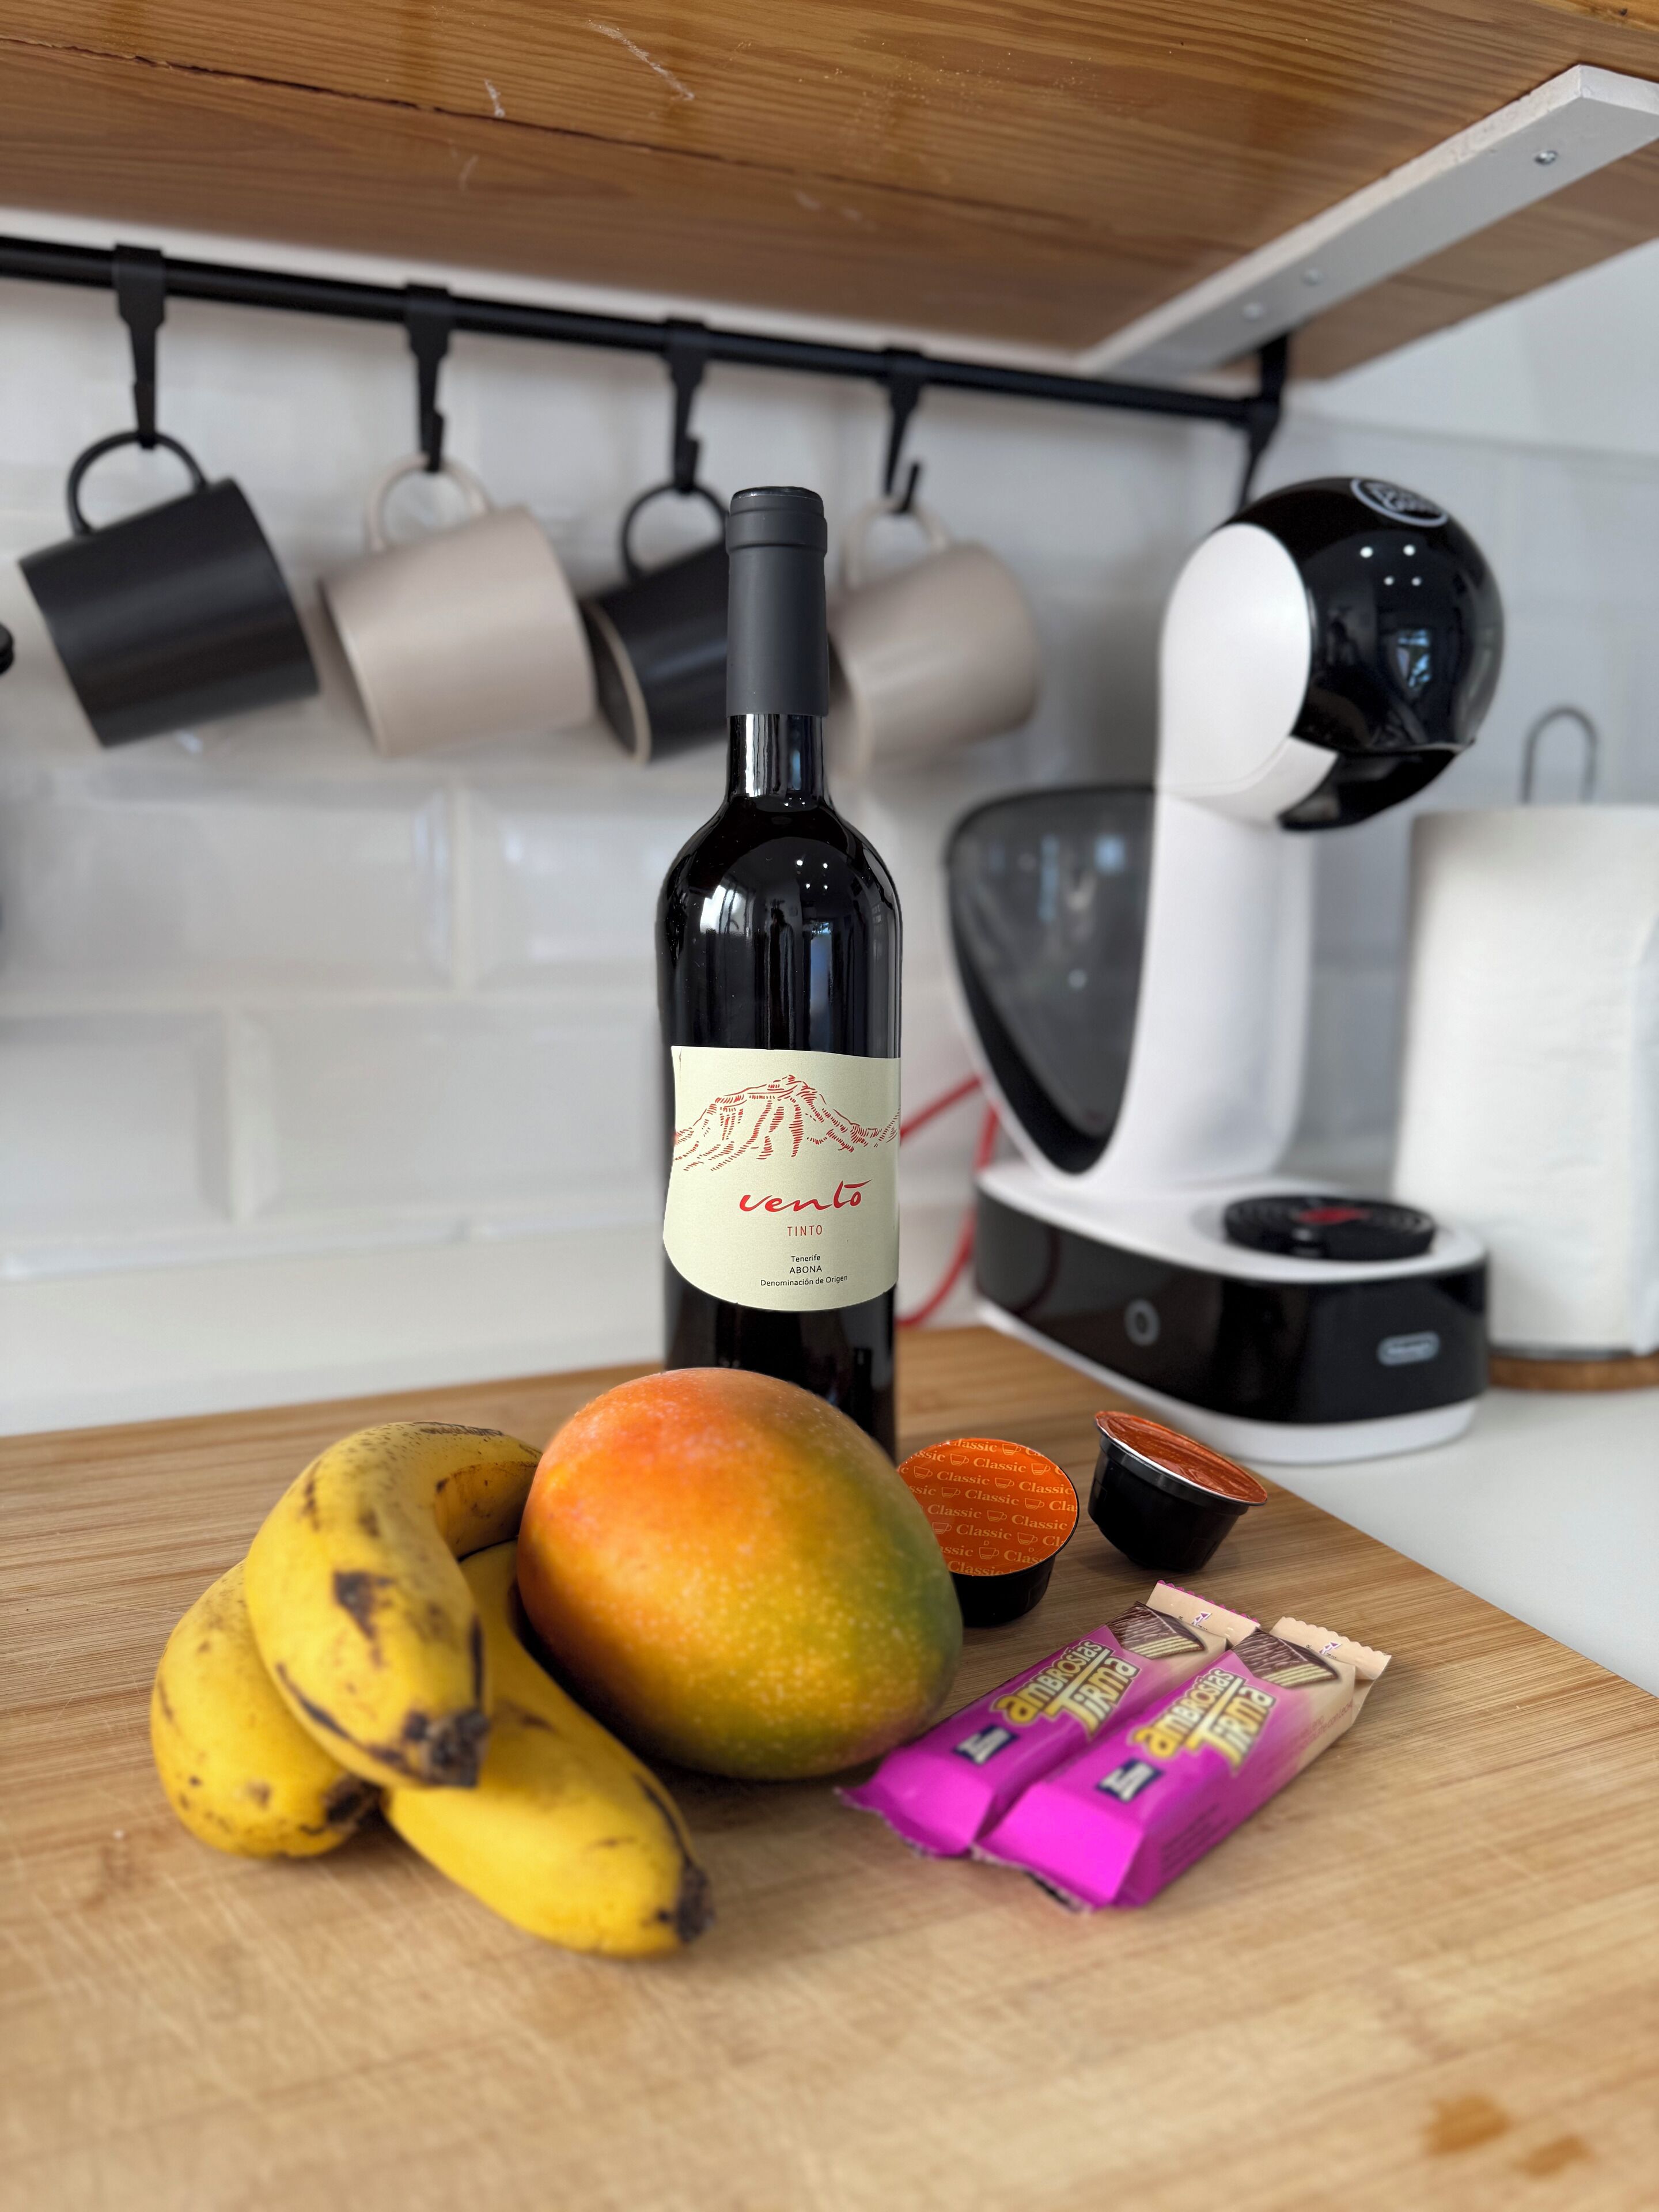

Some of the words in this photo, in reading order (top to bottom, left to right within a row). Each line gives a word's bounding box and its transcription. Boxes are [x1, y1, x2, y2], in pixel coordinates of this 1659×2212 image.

[740, 1179, 873, 1212] vento
[787, 1225, 823, 1236] TINTO
[790, 1254, 821, 1262] Tenerife
[789, 1266, 823, 1274] ABONA
[825, 1275, 848, 1283] Origen
[974, 1457, 1027, 1473] Classic
[937, 1471, 990, 1485] Classic
[1018, 1481, 1073, 1495] Classic
[965, 1489, 1019, 1506] Classic
[927, 1504, 982, 1518] Classic
[1012, 1514, 1067, 1530] Classic
[956, 1524, 1012, 1540] Classic
